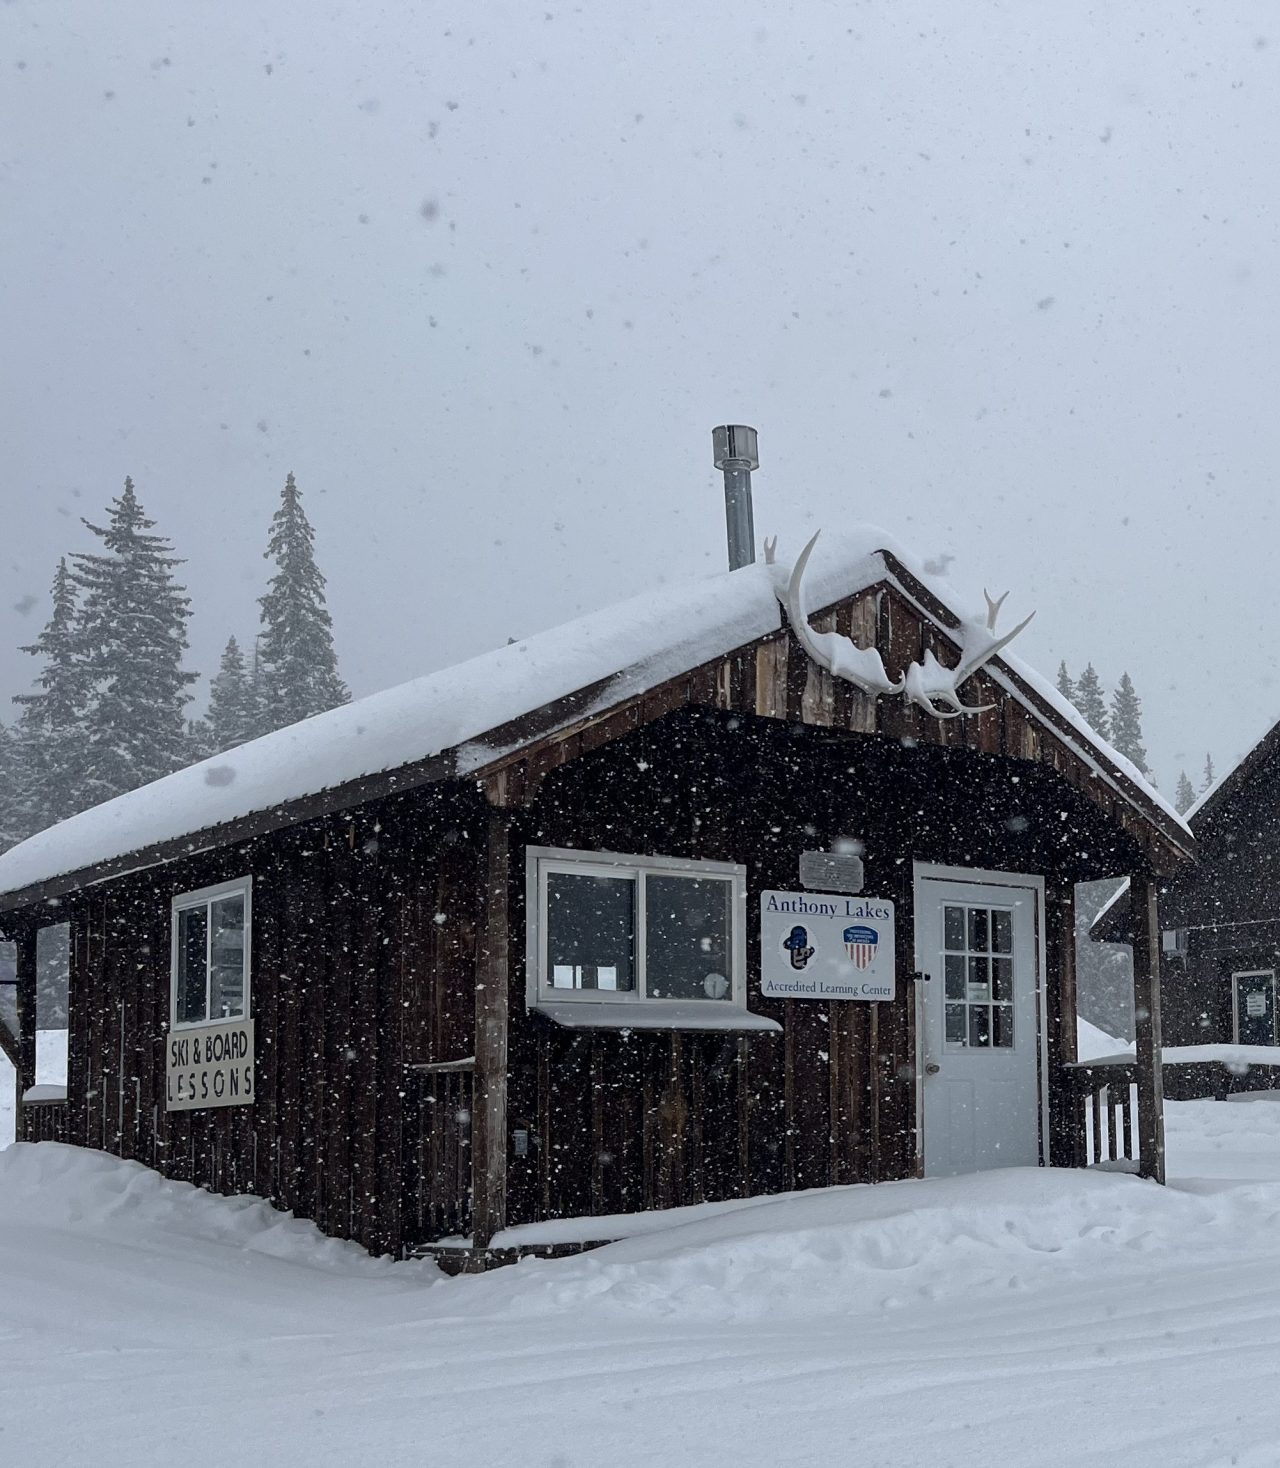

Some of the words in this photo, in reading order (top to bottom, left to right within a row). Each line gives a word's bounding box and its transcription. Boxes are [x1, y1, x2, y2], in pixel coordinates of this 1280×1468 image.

[766, 894, 838, 919] Anthony
[845, 900, 890, 919] Lakes
[766, 980, 816, 993] Accredited
[820, 982, 859, 996] Learning
[861, 983, 892, 996] Center
[171, 1038, 189, 1068] SKI
[193, 1037, 201, 1065] &
[205, 1030, 248, 1063] BOARD
[167, 1065, 252, 1102] LESSONS
